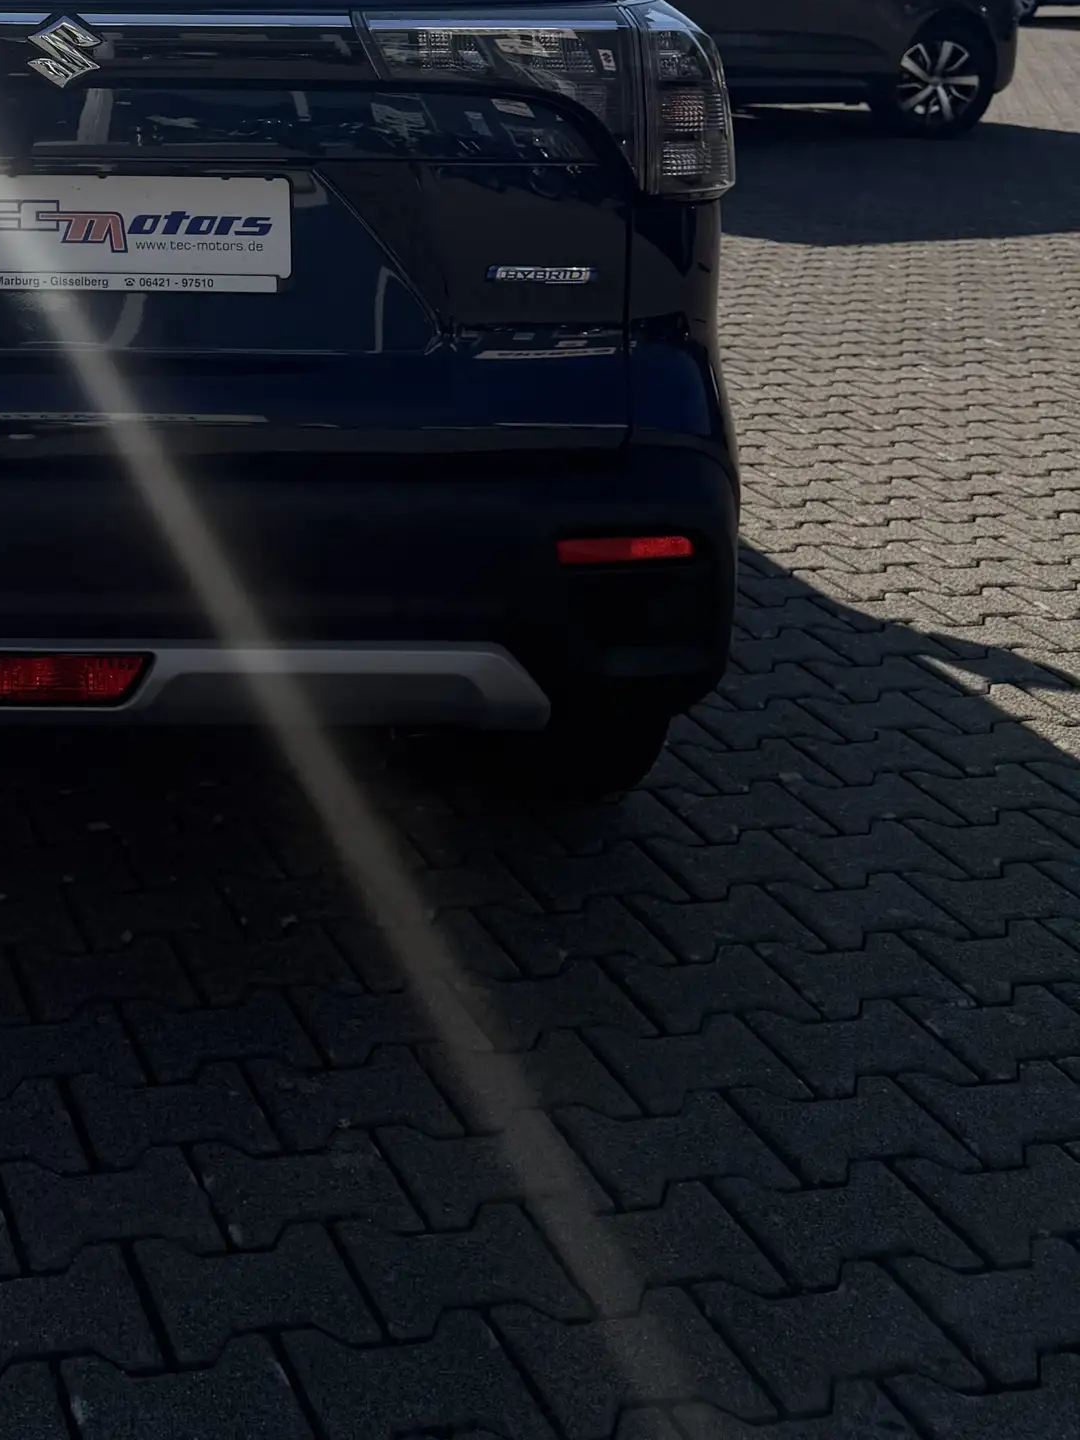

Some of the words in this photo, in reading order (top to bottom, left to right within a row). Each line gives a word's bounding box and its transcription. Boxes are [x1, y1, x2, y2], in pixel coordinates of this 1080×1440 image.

[135, 240, 263, 252] www.tec-motors.de
[499, 268, 586, 282] HYBRID
[50, 276, 109, 288] Gisselberg
[139, 277, 171, 288] 06421
[181, 277, 214, 288] 97510
